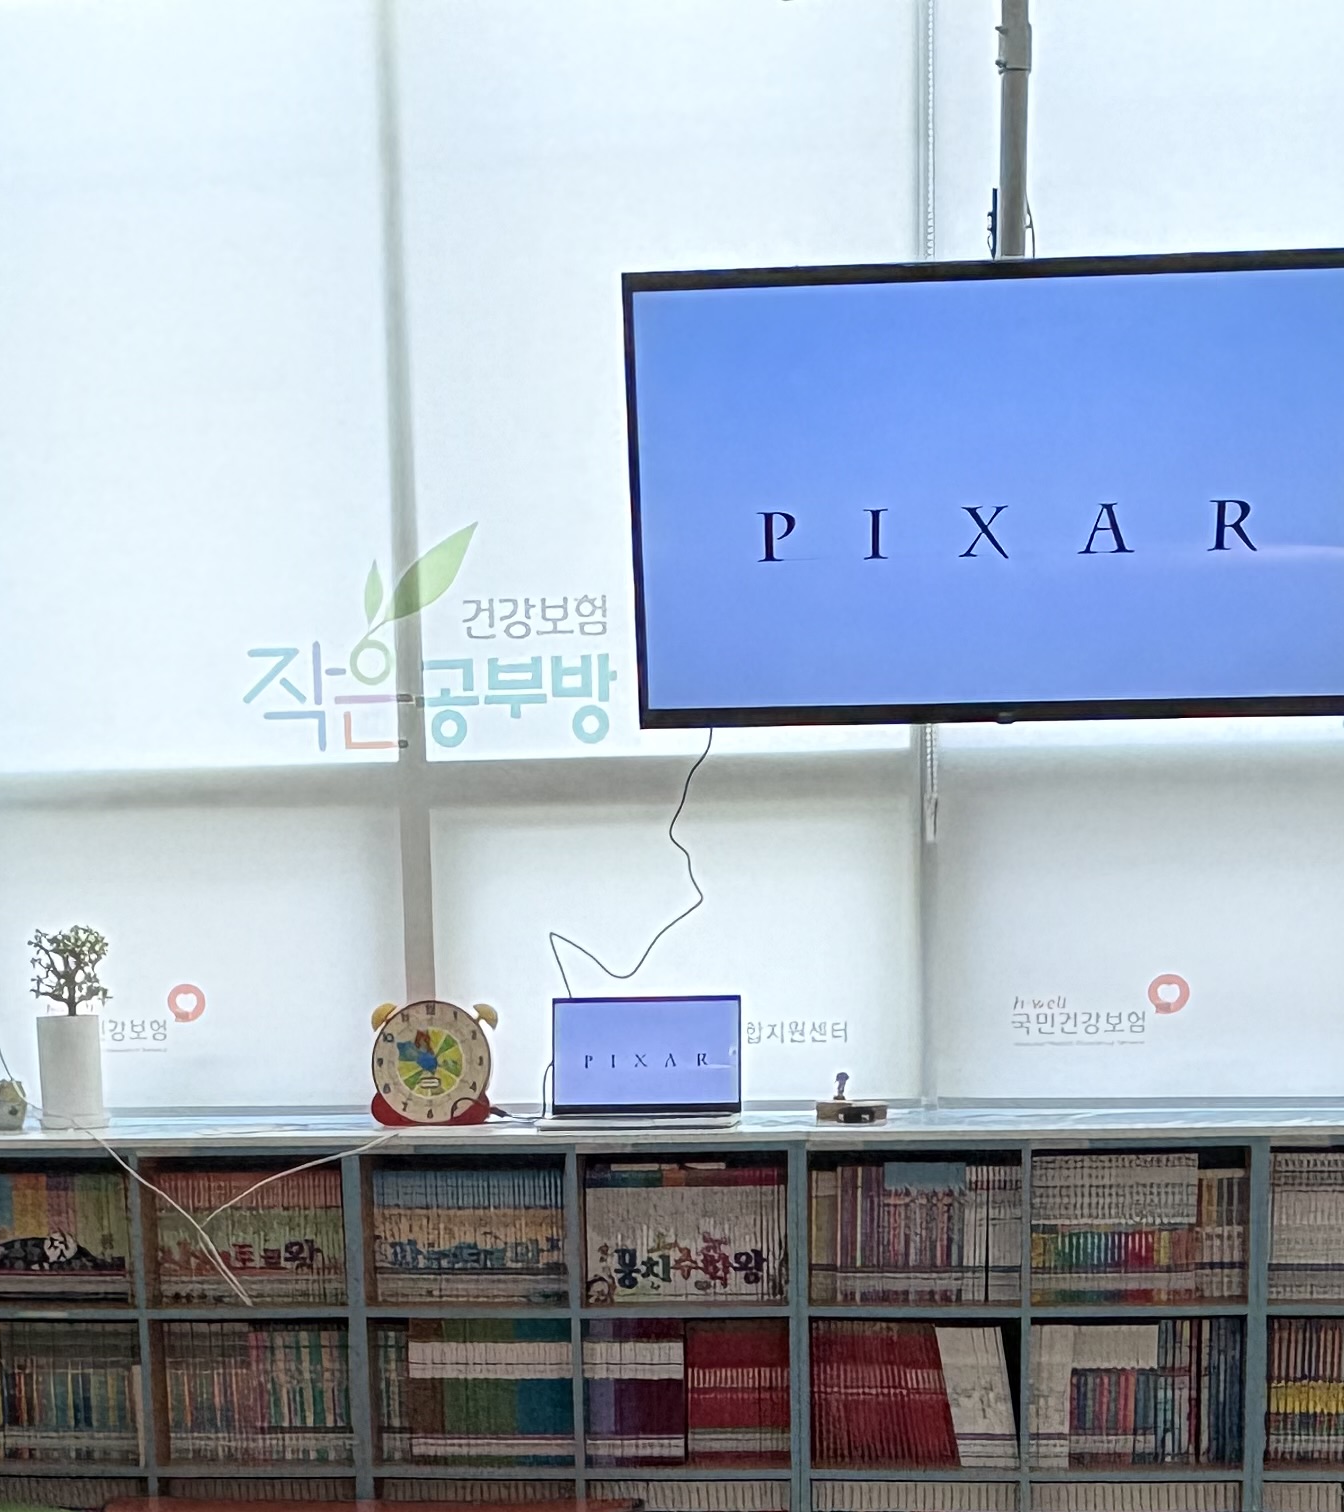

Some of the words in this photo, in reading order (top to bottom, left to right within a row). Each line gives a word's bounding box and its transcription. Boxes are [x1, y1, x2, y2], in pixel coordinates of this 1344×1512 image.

[756, 499, 1258, 563] PIXAR
[462, 594, 608, 639] 건강보험
[583, 1052, 709, 1070] PIXAR
